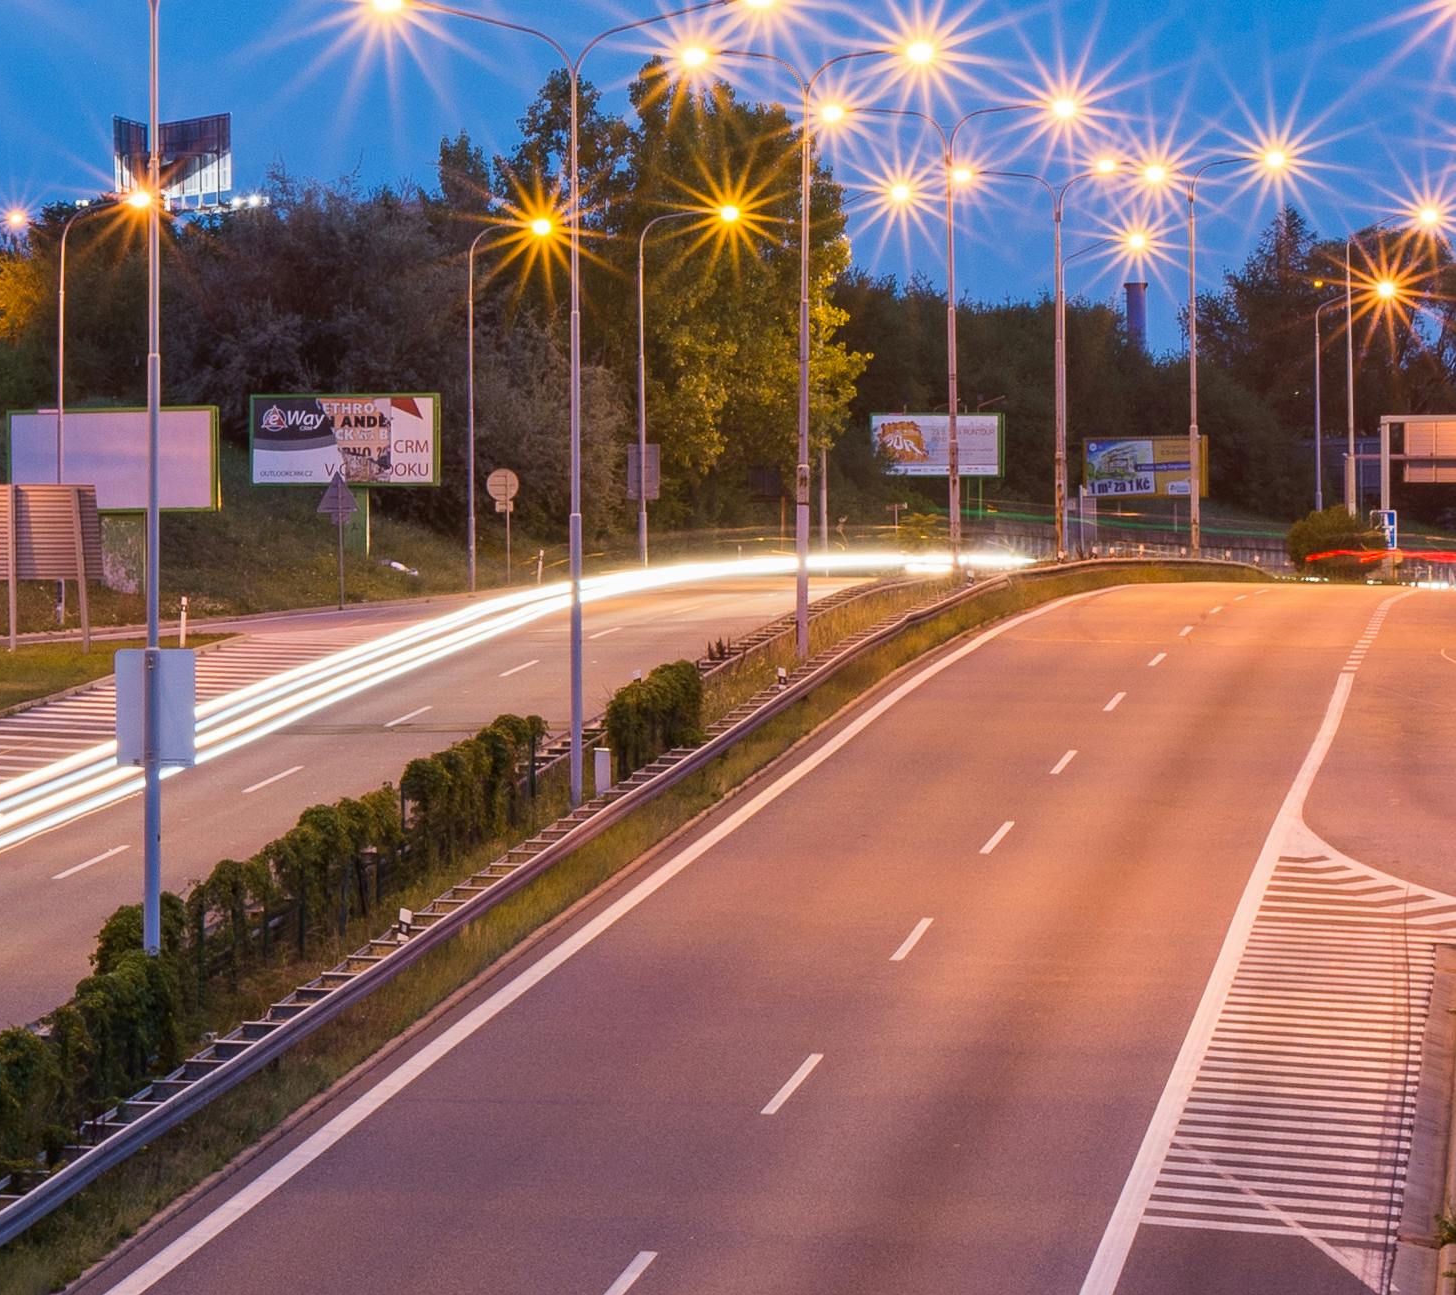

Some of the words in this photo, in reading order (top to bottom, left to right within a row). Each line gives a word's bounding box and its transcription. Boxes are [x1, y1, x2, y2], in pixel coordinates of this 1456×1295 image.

[394, 439, 429, 453] CRM
[1114, 482, 1126, 492] za
[1136, 478, 1150, 491] Kč
